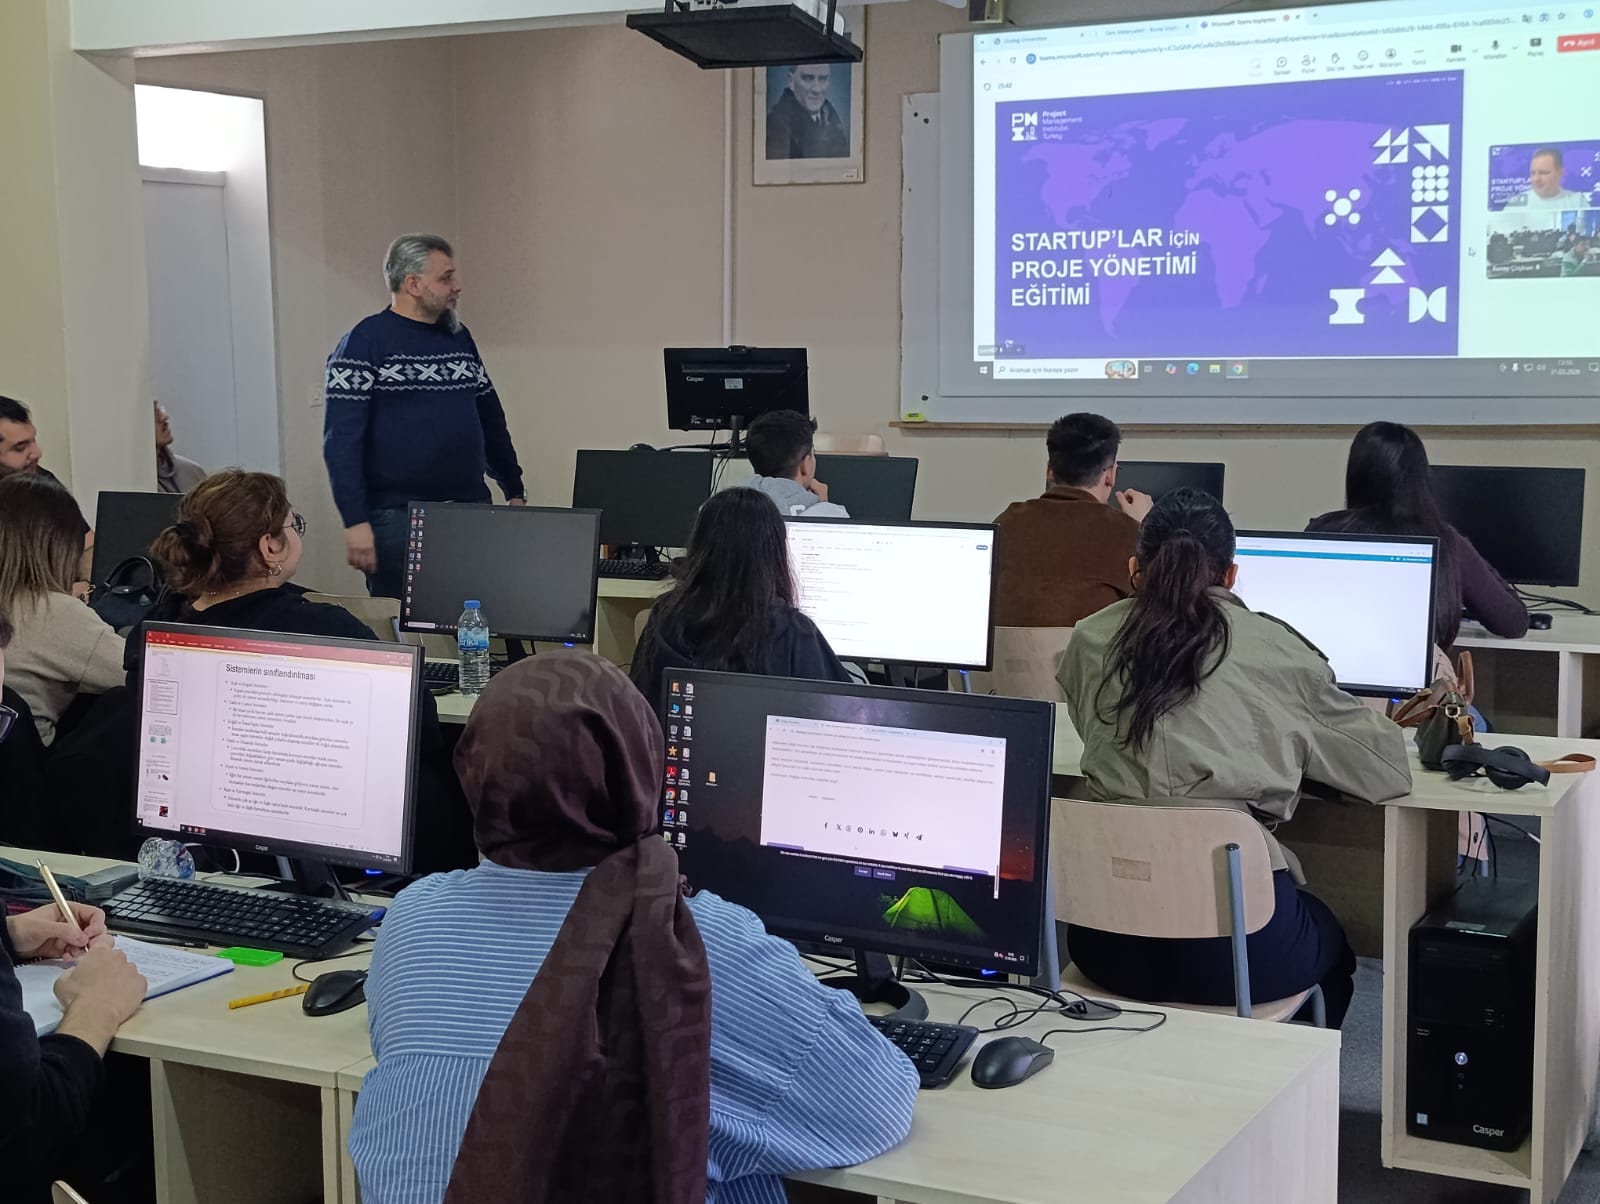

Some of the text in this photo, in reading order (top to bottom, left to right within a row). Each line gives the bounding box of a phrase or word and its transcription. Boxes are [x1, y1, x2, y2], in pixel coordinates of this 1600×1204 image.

[1042, 110, 1066, 119] Project
[1011, 251, 1197, 279] PROJE YÖNETİMİ
[1011, 282, 1091, 307] EĞİTİMİ
[226, 664, 262, 675] Sistemlerin
[824, 934, 844, 944] Casper
[1472, 1124, 1505, 1137] Casper
